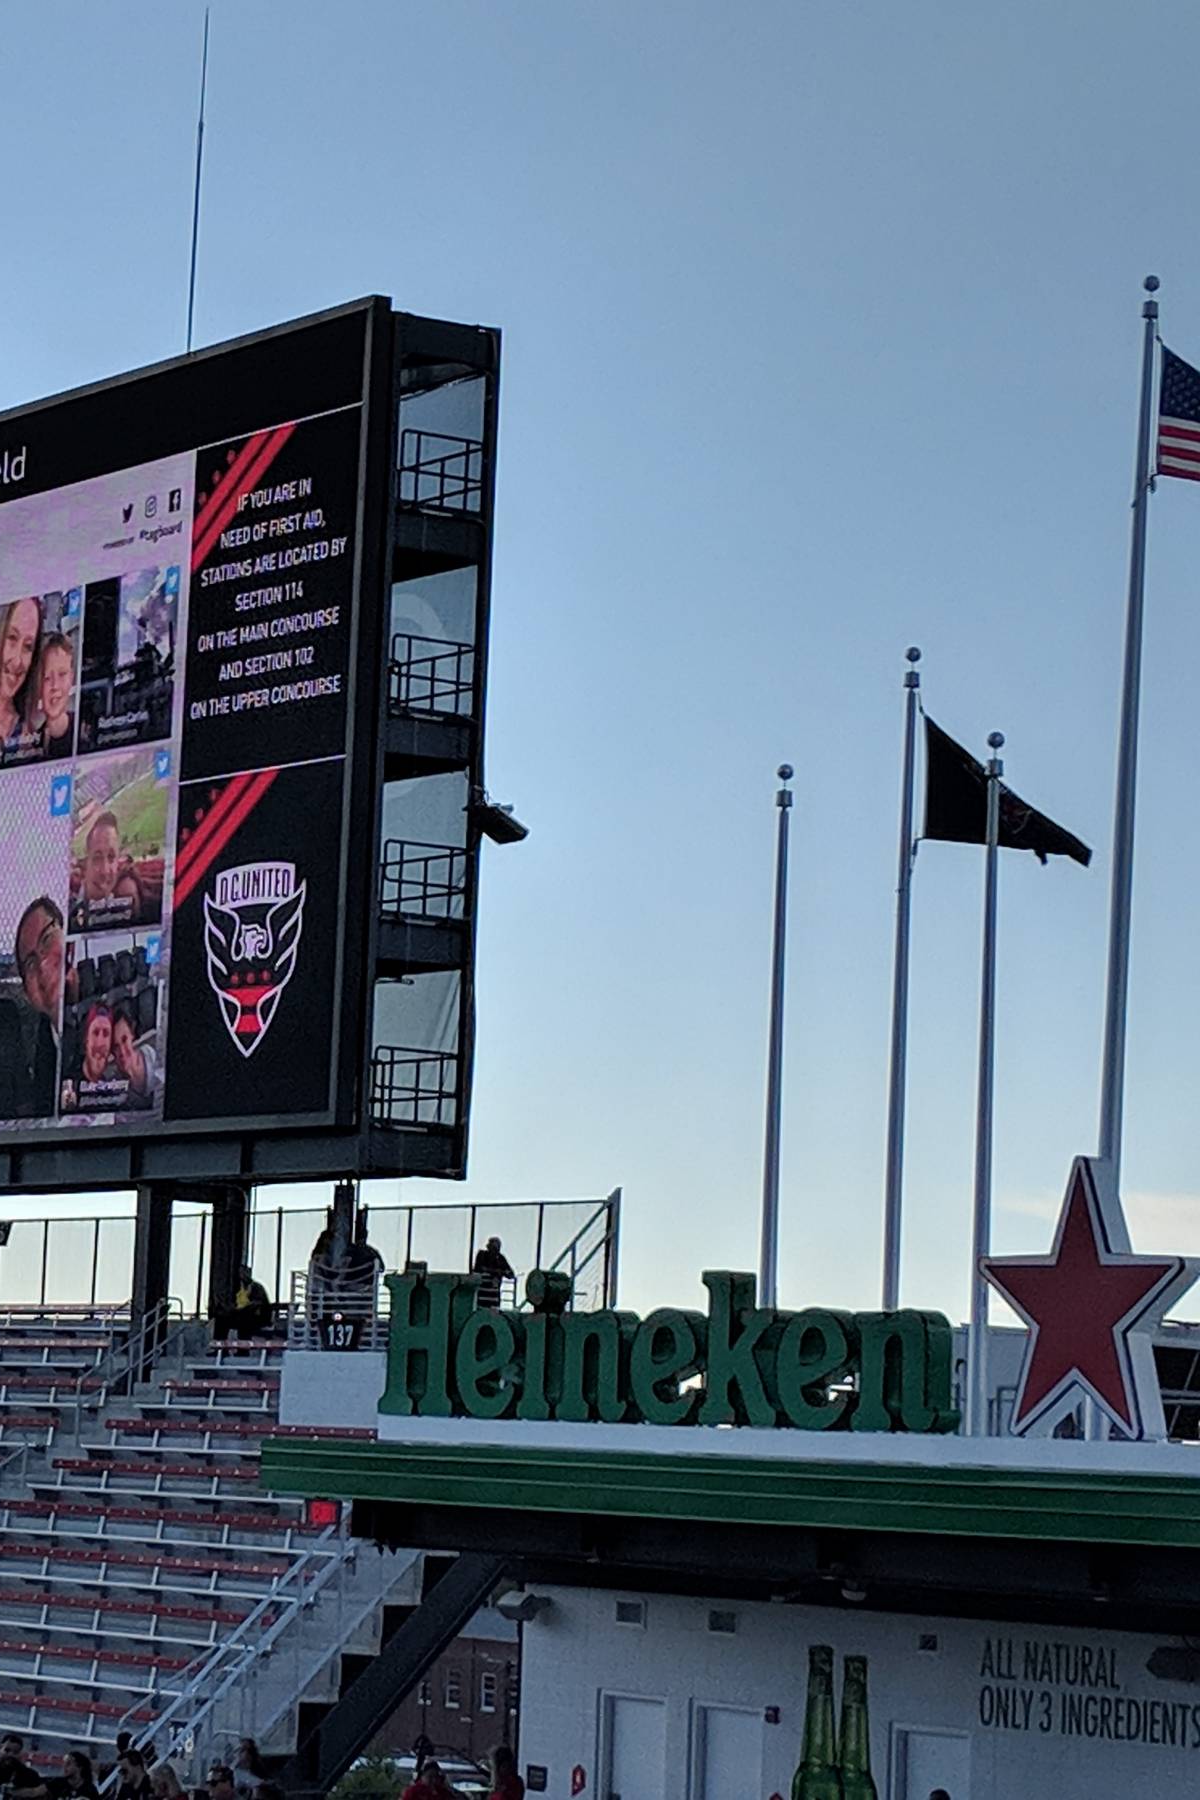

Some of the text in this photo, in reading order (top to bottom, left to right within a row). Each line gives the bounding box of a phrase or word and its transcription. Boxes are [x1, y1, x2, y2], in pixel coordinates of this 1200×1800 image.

[237, 477, 312, 512] IF YOU ARE IN
[220, 526, 250, 549] NEED
[252, 521, 268, 542] OF
[269, 512, 302, 538] FIRST
[200, 536, 348, 588] STATIONS ARE LOCATED BY
[234, 586, 283, 612] SECTION
[197, 605, 341, 652] ON THE MAIN CONCOURSE
[218, 645, 314, 682] AND SECTION 102
[190, 674, 342, 720] ON THE UPPER CONCOURSE
[328, 1324, 354, 1347] 137
[378, 1268, 960, 1434] Heineken
[979, 1637, 1017, 1680] ALL
[979, 1685, 1200, 1749] ONLY 3 INGREDIENTS
